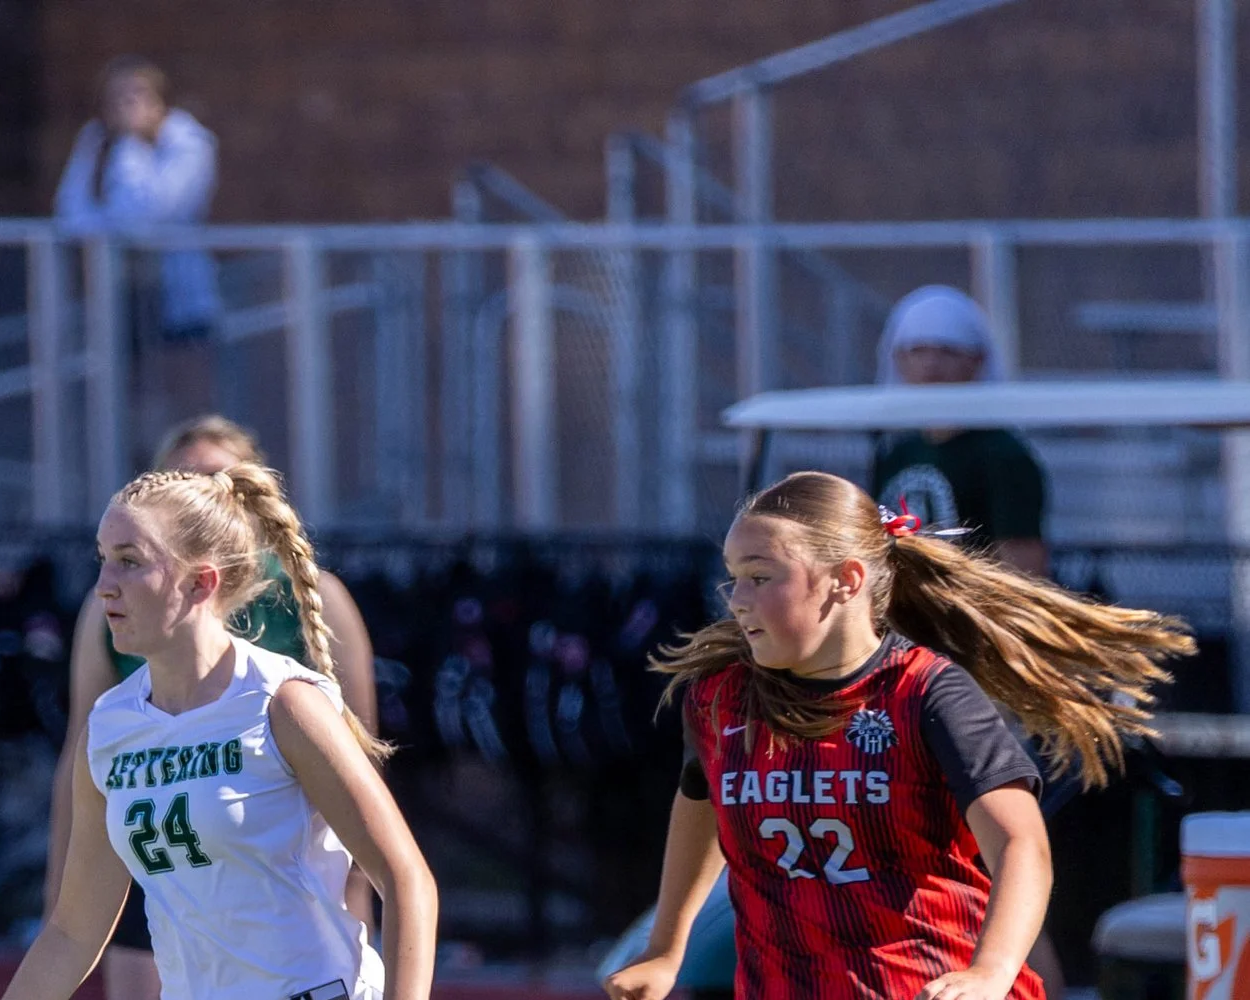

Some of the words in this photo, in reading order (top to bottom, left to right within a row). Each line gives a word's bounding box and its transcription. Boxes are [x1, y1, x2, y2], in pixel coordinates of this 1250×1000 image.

[720, 770, 891, 805] EAGLETS
[124, 791, 212, 875] 24
[758, 817, 871, 885] 22
[1190, 897, 1223, 979] G
